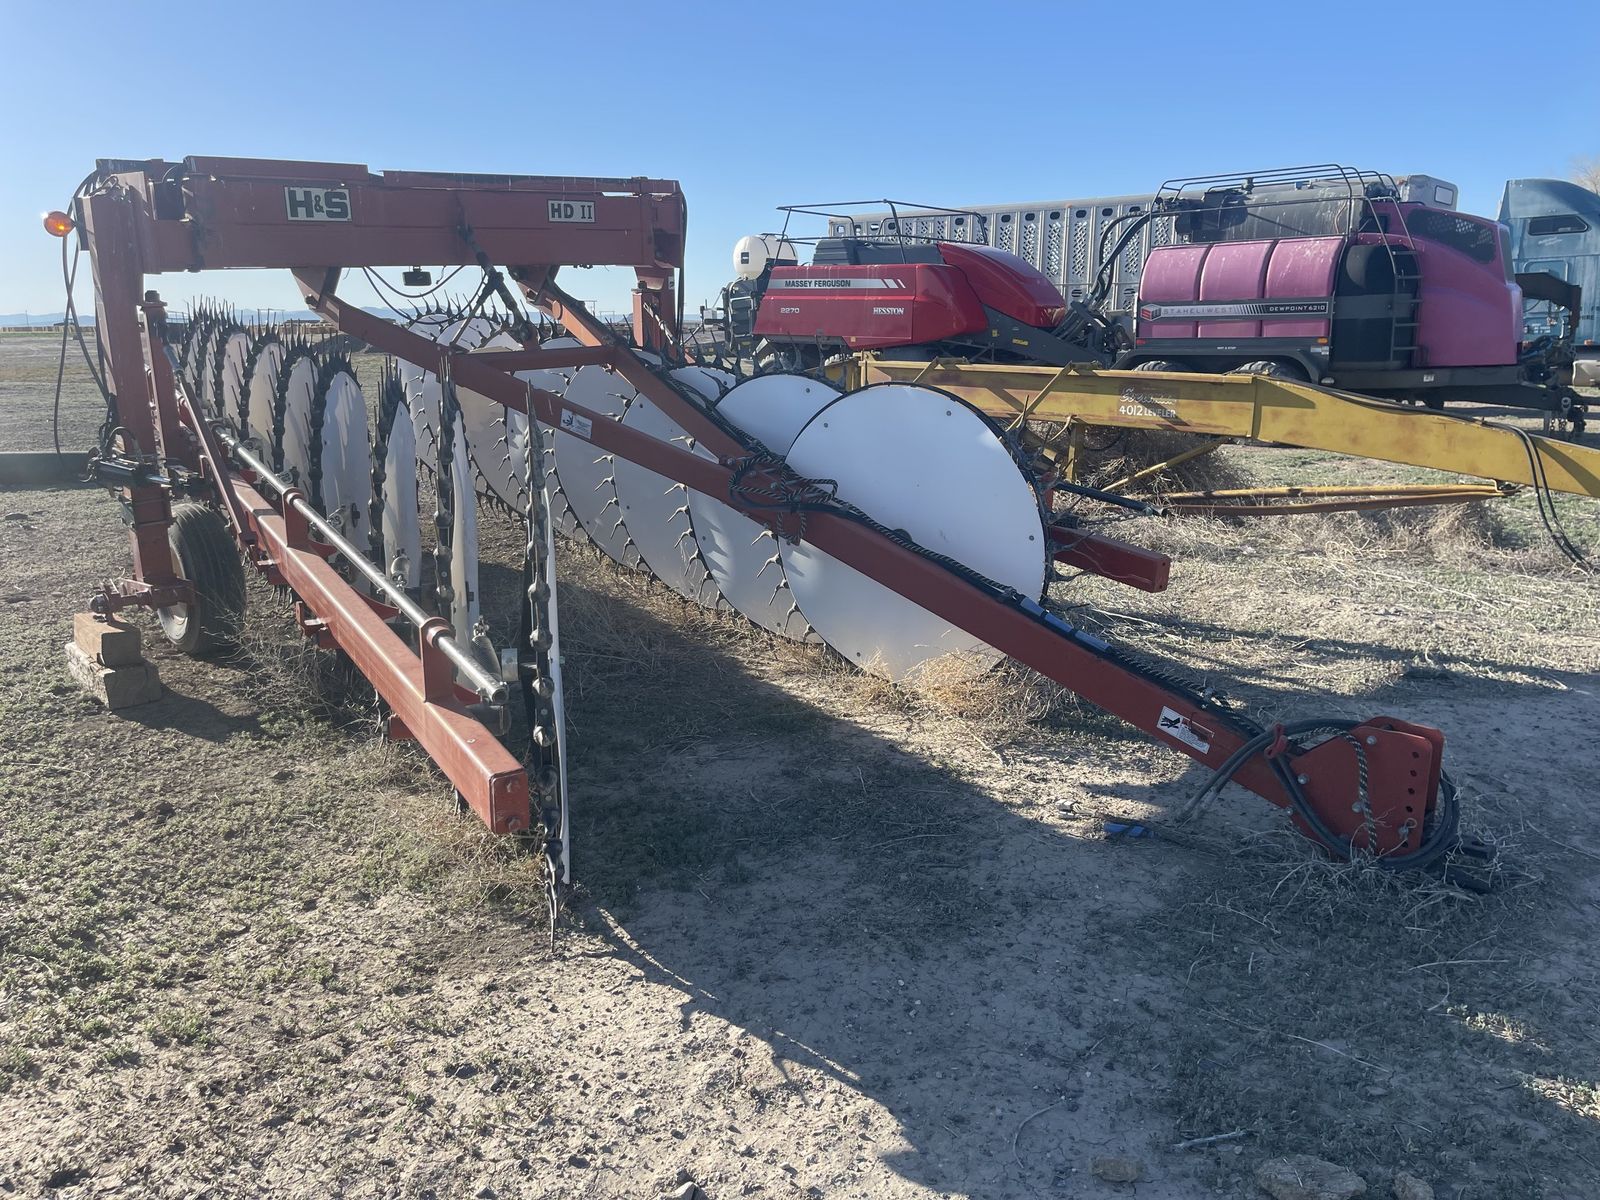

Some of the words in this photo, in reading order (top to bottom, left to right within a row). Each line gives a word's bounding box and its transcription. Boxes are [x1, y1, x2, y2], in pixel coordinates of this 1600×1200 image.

[288, 189, 349, 219] H&S
[551, 203, 574, 219] HD
[580, 204, 593, 220] II
[784, 280, 812, 288] MASSEY
[814, 280, 851, 288] FERGUSON
[873, 307, 905, 315] HESSTON
[1119, 405, 1143, 416] 4012
[1144, 408, 1176, 418] LEVELER
